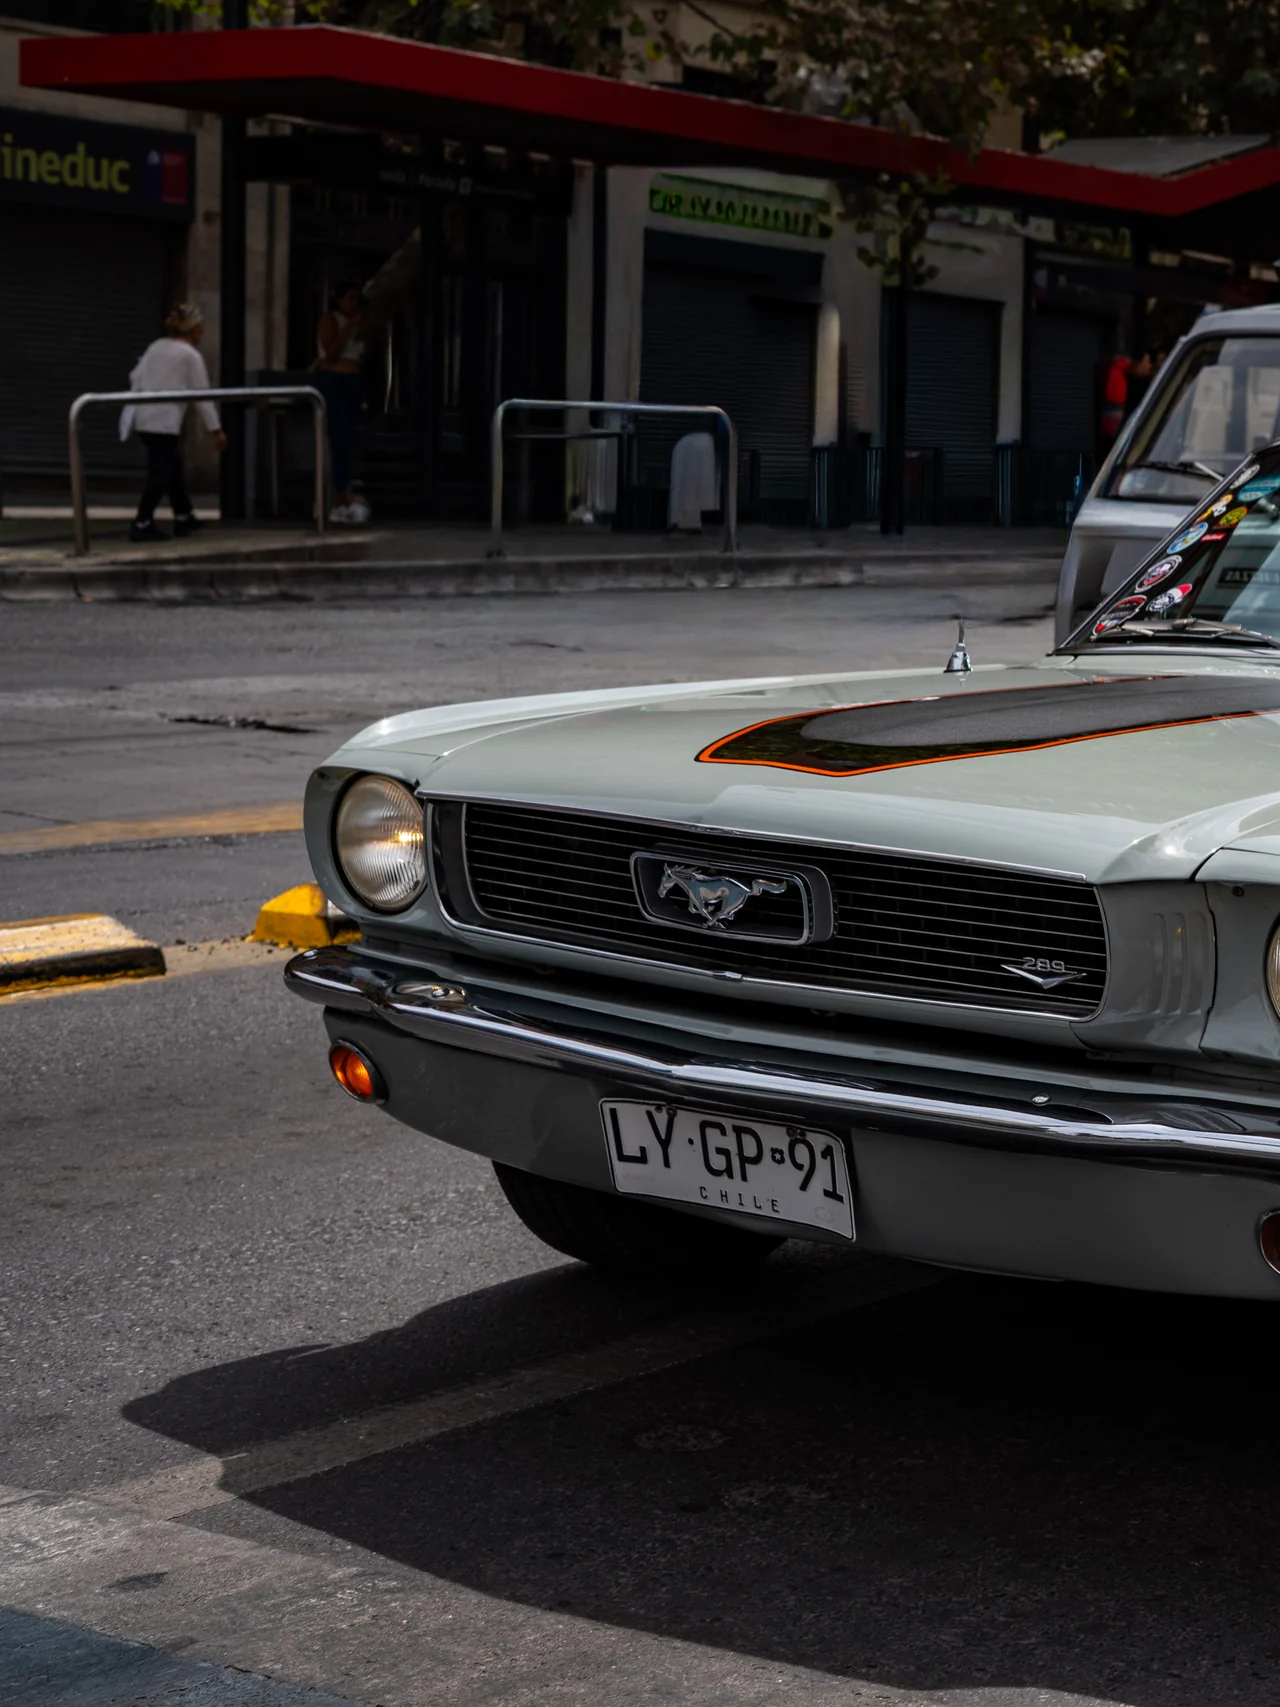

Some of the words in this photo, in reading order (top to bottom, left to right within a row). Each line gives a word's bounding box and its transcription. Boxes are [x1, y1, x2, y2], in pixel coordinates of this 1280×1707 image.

[0, 132, 131, 194] ineduc
[1021, 956, 1065, 973] 289
[699, 1186, 781, 1213] CHILE
